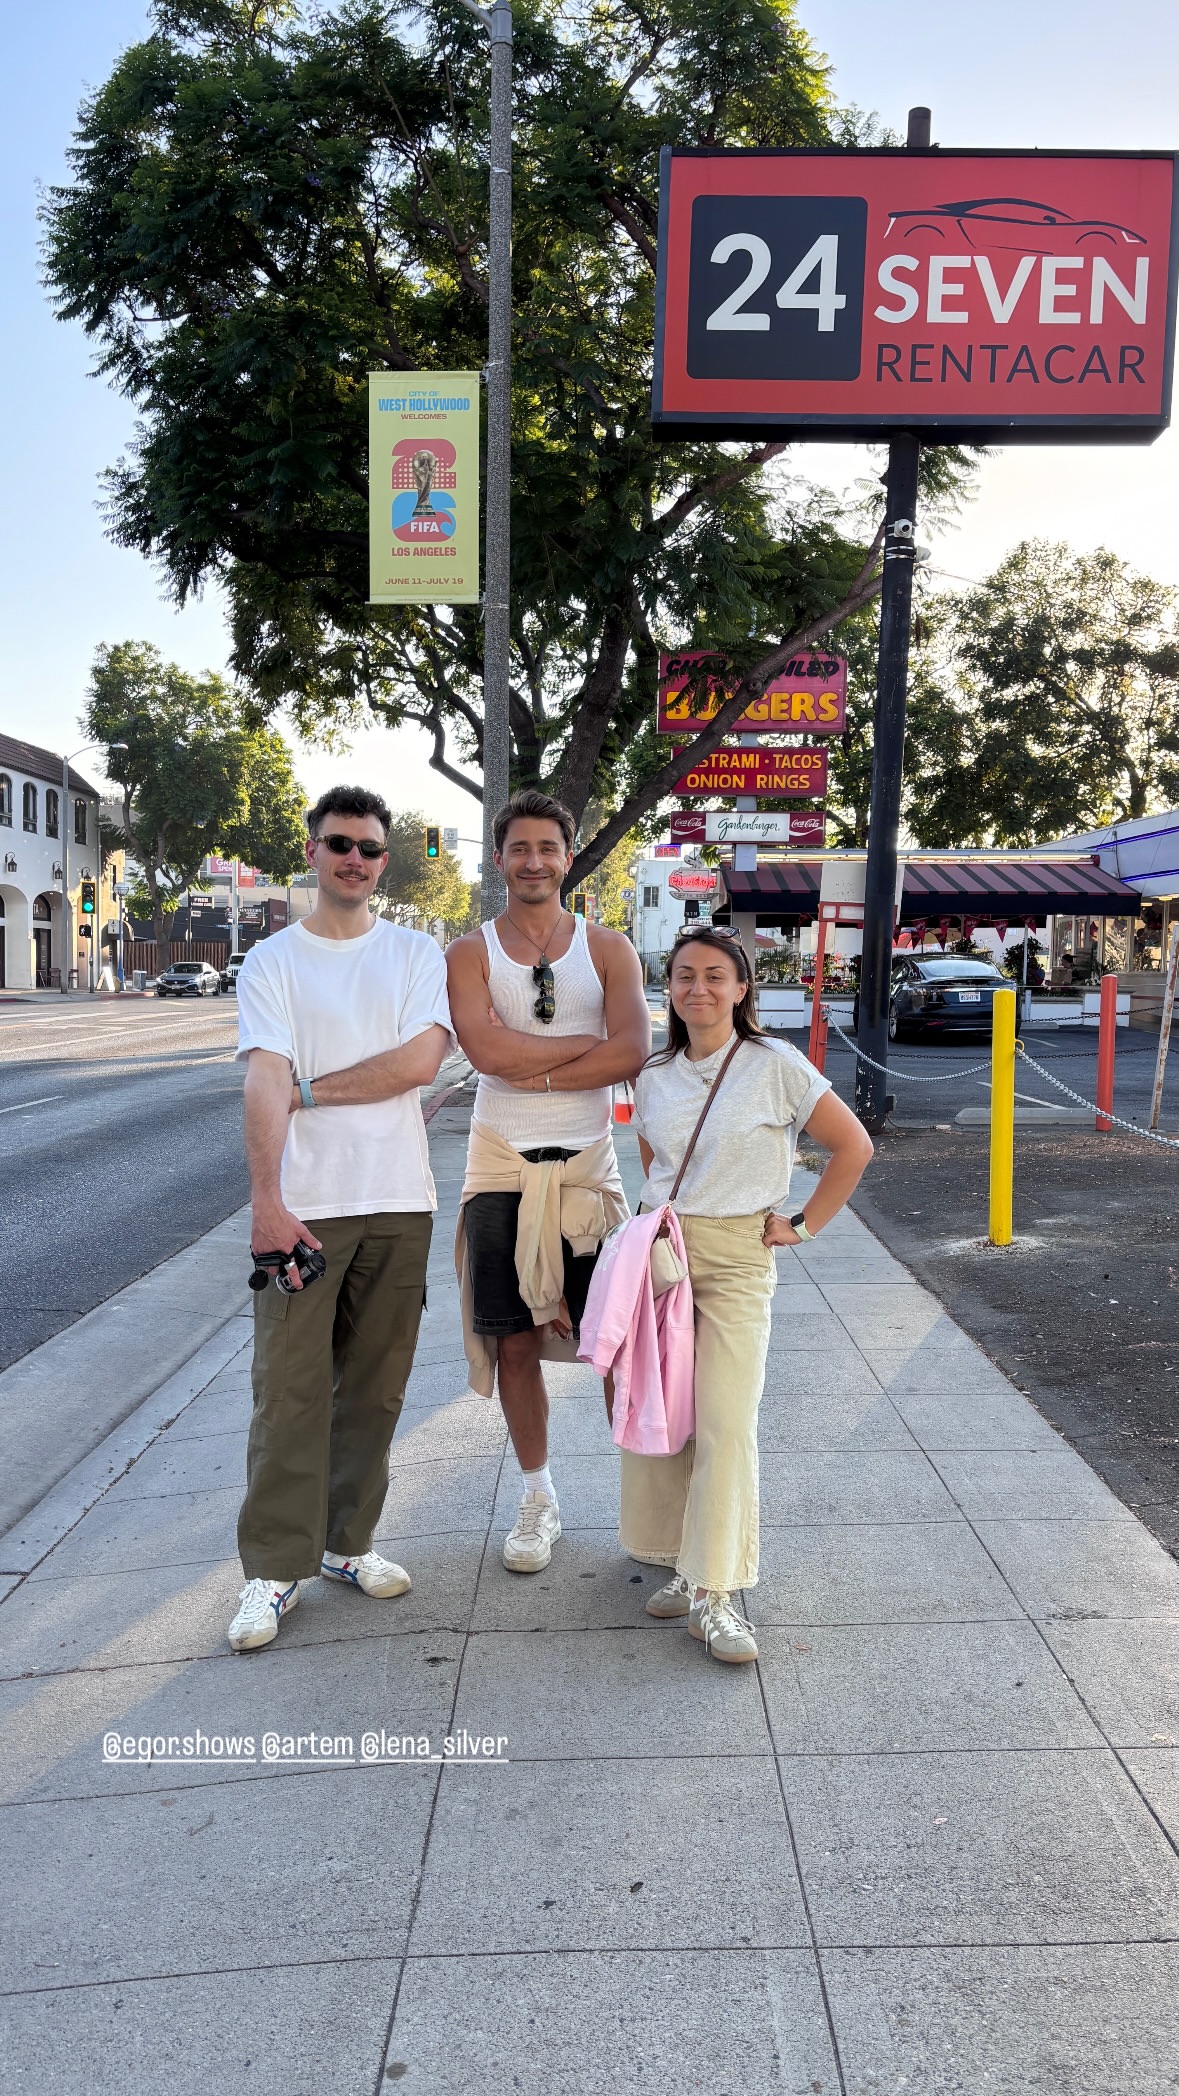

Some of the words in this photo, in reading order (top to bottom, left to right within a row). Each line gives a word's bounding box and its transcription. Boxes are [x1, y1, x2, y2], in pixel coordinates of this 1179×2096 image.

[705, 232, 847, 332] 24
[873, 253, 1150, 325] SEVEN
[876, 343, 1146, 384] RENTACAR
[378, 398, 408, 411] WEST
[409, 397, 470, 411] HOLLYWOOD
[410, 521, 440, 533] FIFA
[391, 547, 410, 557] LOS
[412, 547, 457, 557] ANGELES
[452, 577, 463, 585] 19
[695, 753, 760, 768] STRAMI
[773, 754, 822, 769] TACOS
[686, 774, 745, 789] ONION
[756, 774, 811, 789] RINGS
